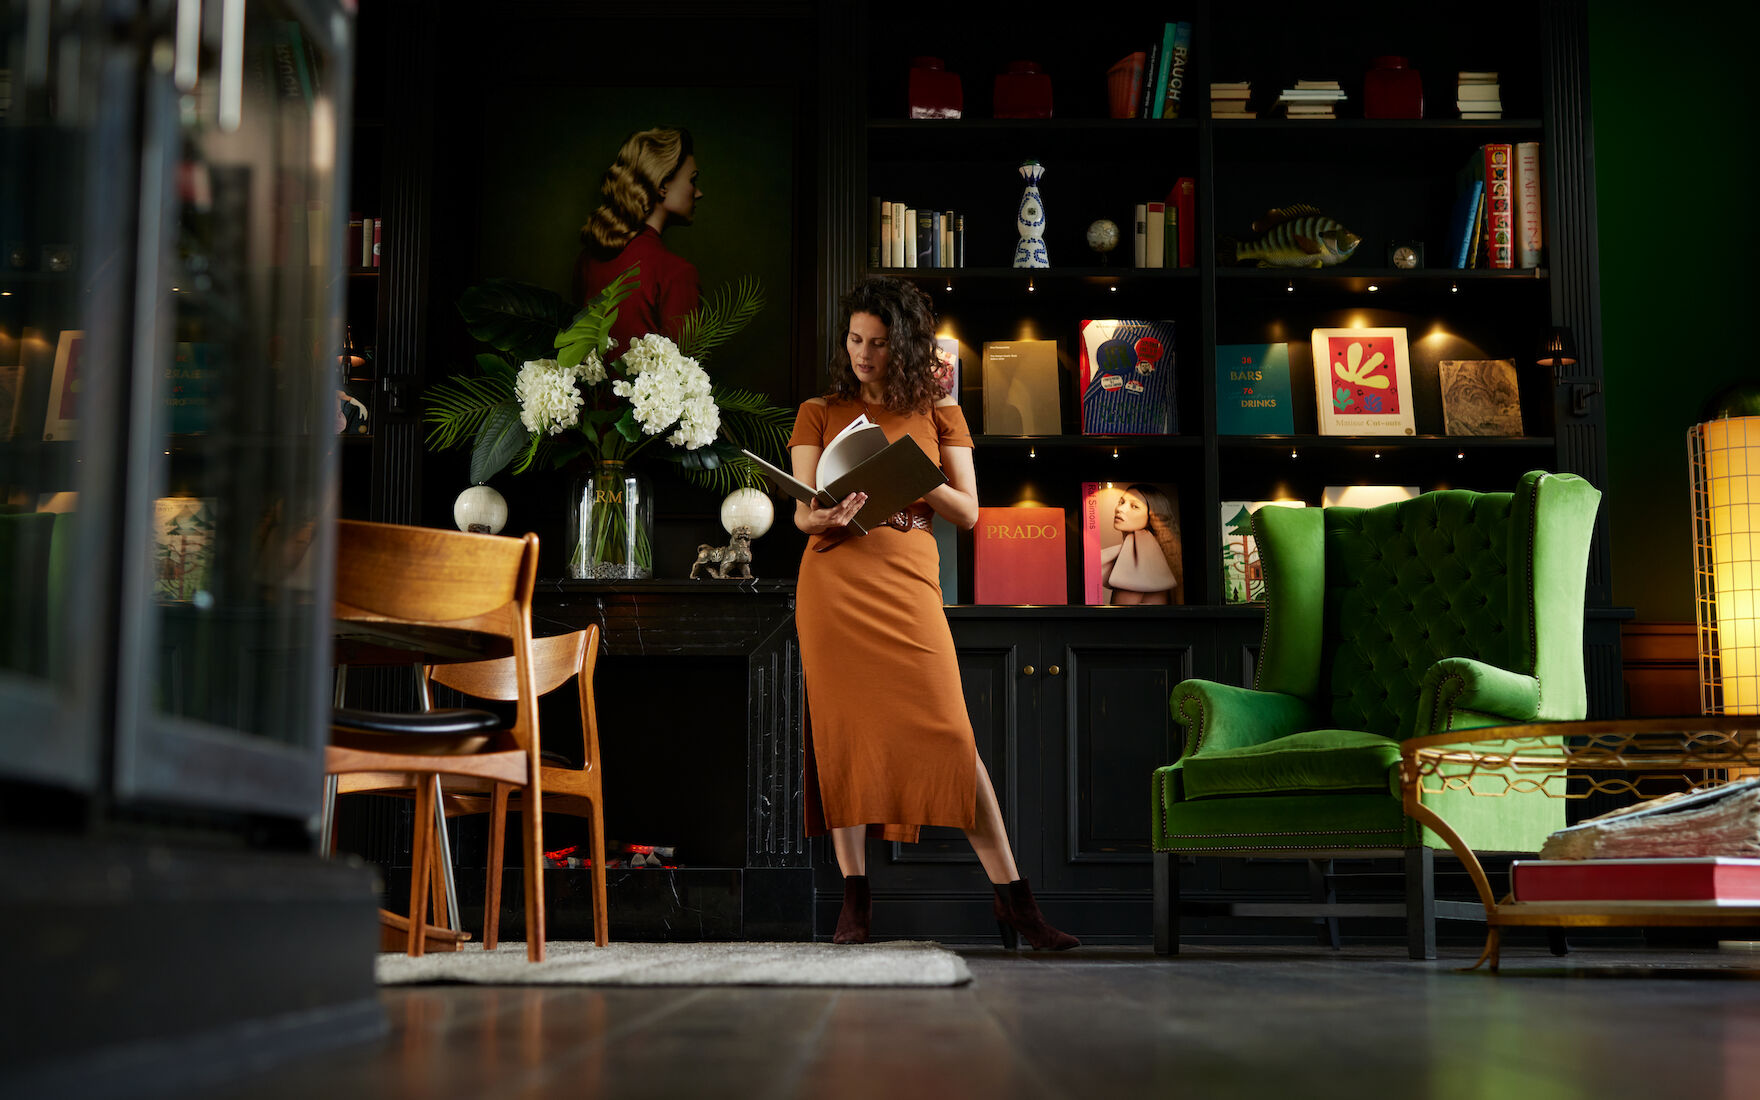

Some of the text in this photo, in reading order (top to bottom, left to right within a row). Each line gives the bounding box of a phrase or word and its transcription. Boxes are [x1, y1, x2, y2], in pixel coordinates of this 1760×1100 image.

[1168, 46, 1187, 100] RAUCH
[1103, 345, 1132, 370] JFK
[1230, 370, 1263, 381] BARS
[1243, 387, 1254, 395] 76
[1241, 399, 1277, 408] DRINKS
[595, 490, 622, 504] RM
[1087, 484, 1097, 530] Raf Simons
[985, 524, 1057, 540] PRADO
